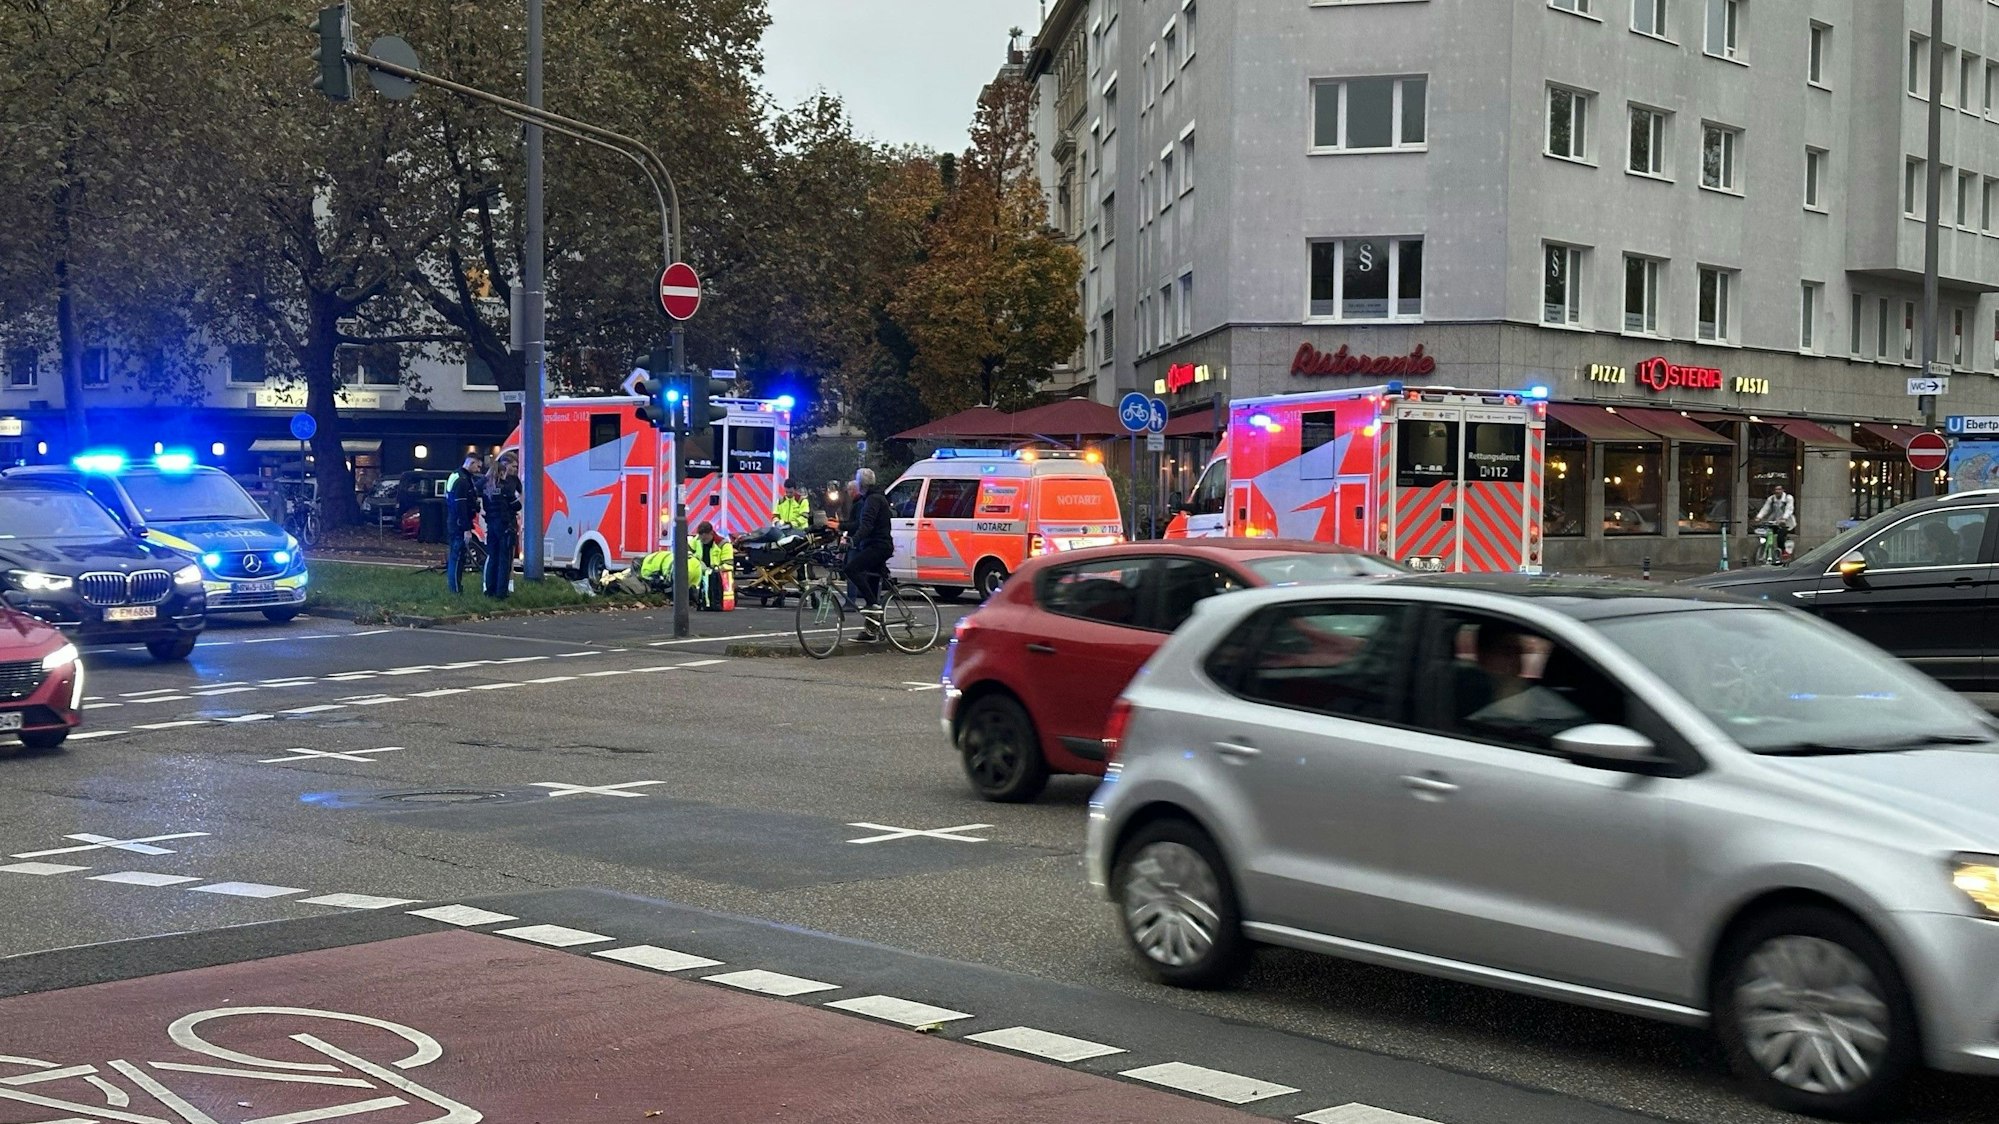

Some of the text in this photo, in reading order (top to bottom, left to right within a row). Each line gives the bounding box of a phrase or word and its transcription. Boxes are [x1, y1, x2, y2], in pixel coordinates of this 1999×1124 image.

[1290, 342, 1437, 377] Ristorante
[1590, 363, 1626, 384] PIZZA
[1736, 376, 1769, 395] PASTA
[1911, 382, 1926, 391] WC
[1468, 452, 1521, 463] Rettungsdienst
[748, 461, 762, 471] 112
[1491, 466, 1508, 478] 112
[1056, 495, 1102, 506] NOTARZT
[976, 522, 1013, 532] NOTARZT
[202, 530, 266, 539] POLIZEI
